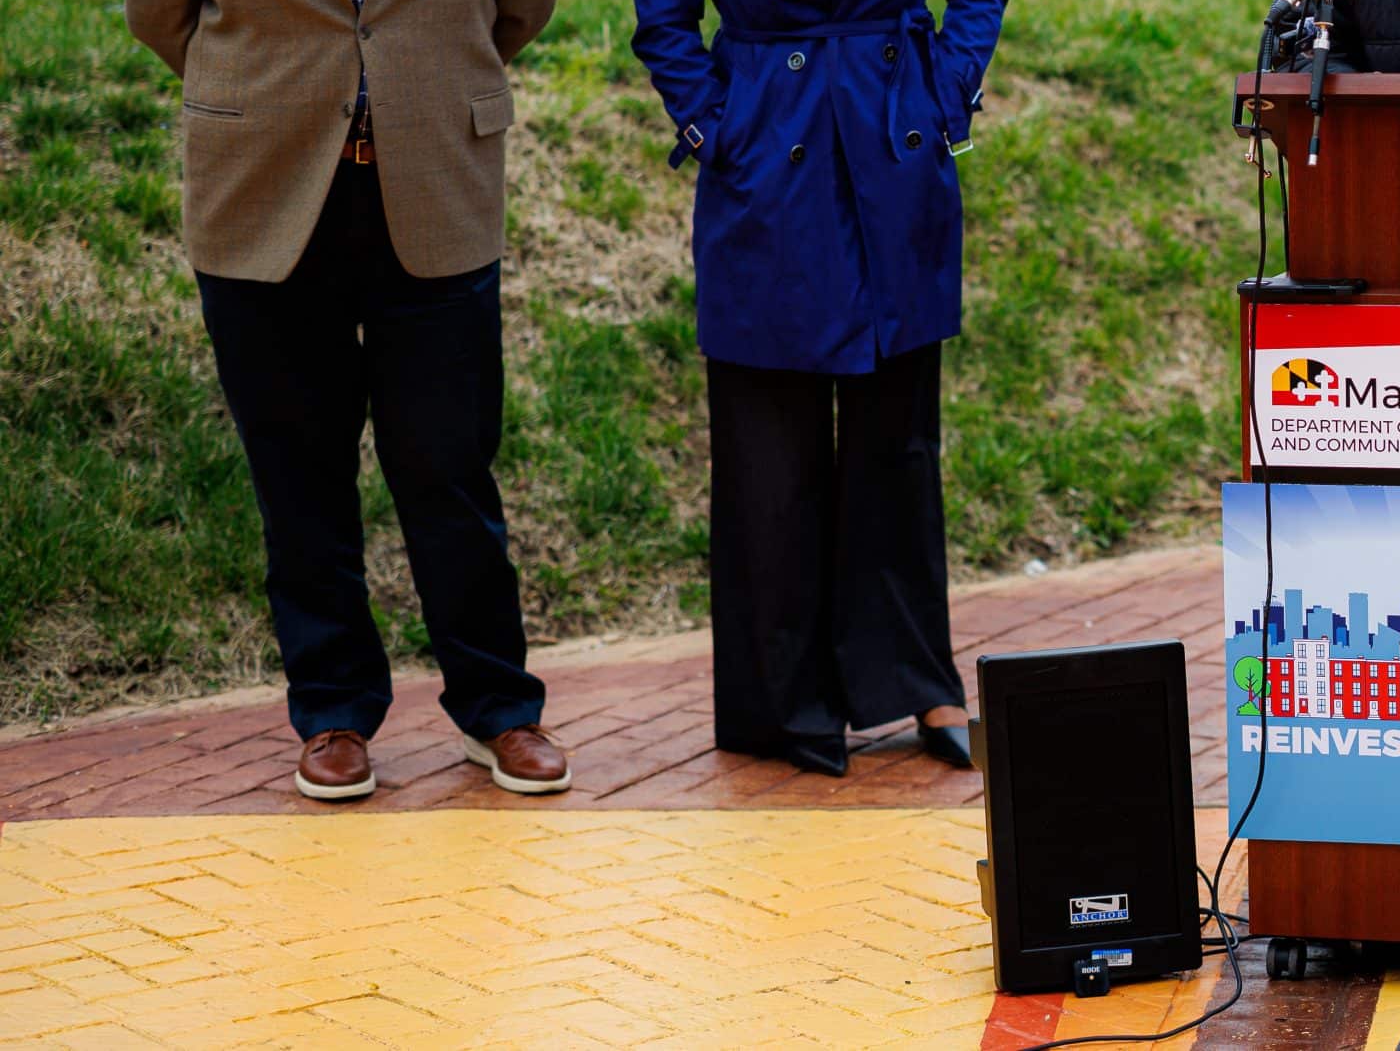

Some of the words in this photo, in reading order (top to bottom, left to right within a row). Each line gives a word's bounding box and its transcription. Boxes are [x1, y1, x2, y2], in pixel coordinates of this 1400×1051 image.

[1271, 418, 1393, 434] DEPARTMENT
[1271, 437, 1311, 452] AND
[1072, 909, 1127, 922] ANCHOR
